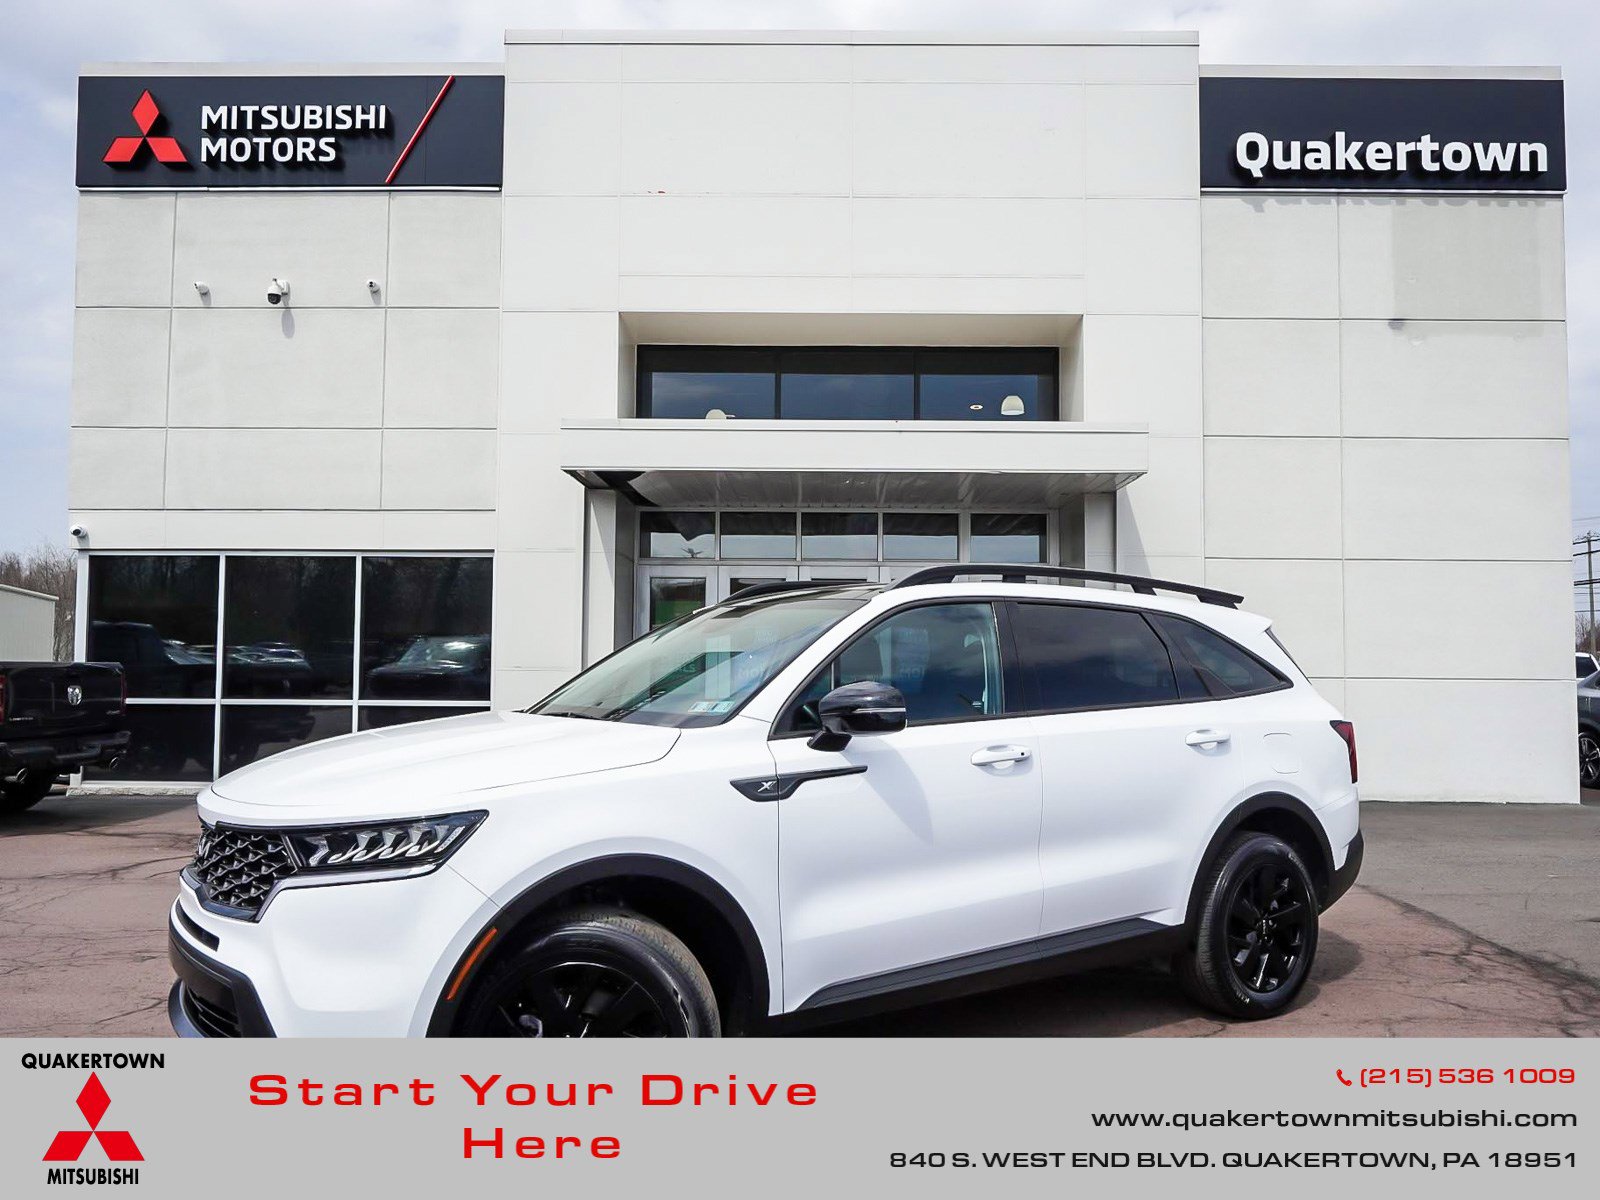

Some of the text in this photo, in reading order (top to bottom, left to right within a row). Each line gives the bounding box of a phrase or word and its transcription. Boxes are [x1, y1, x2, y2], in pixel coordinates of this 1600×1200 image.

[201, 104, 387, 130] MITSUBISHI
[200, 137, 336, 162] MOTORS
[1236, 131, 1548, 178] Quakertown
